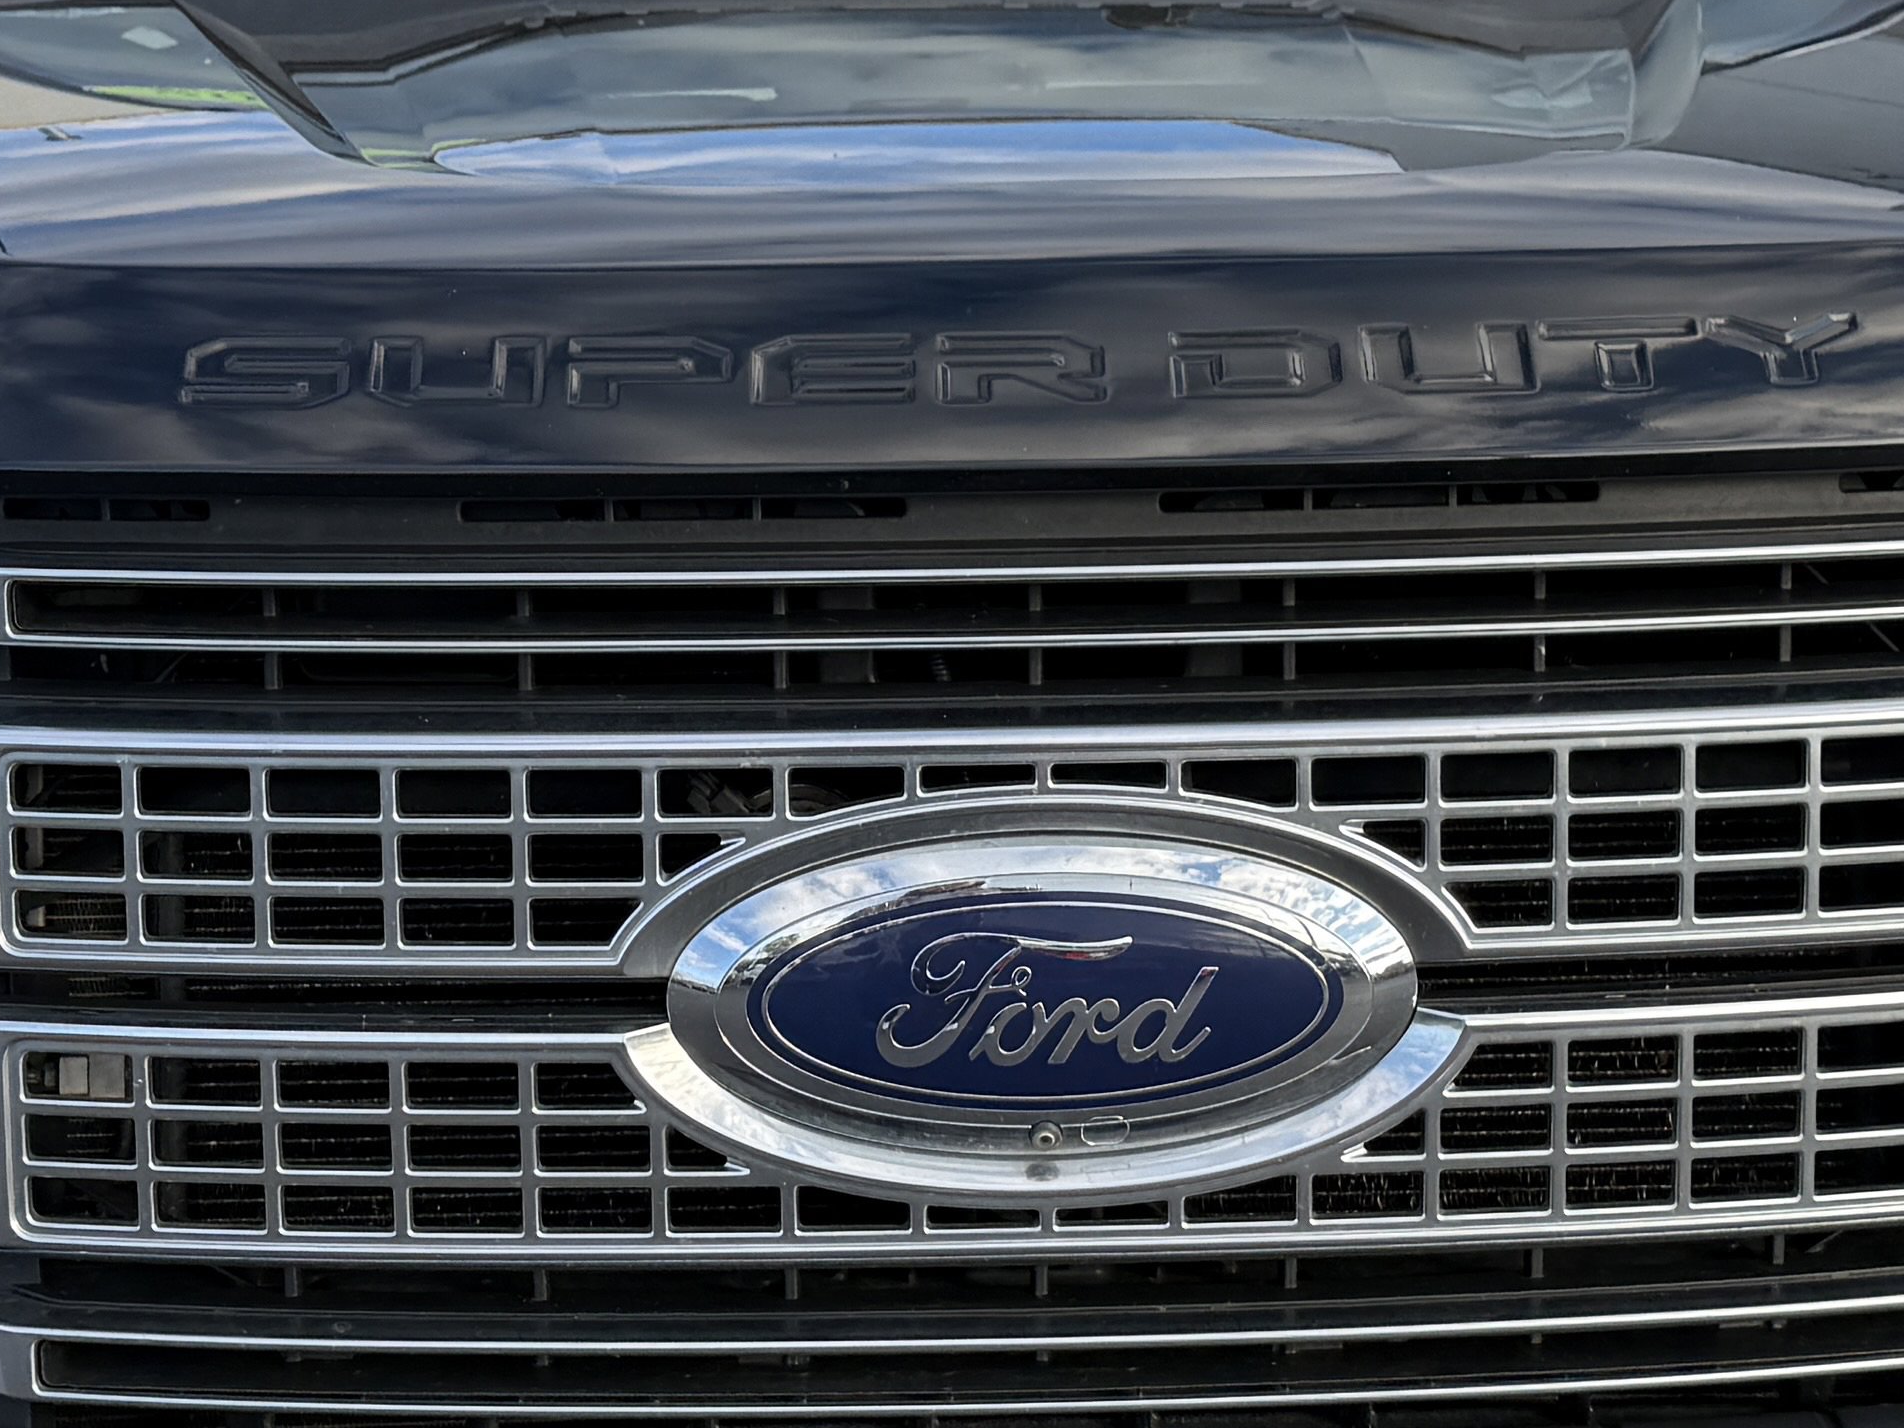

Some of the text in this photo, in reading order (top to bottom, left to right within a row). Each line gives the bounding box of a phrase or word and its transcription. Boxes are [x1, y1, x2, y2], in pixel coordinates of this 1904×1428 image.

[178, 312, 1859, 410] SUPER DUTY
[875, 931, 1220, 1067] Ford
